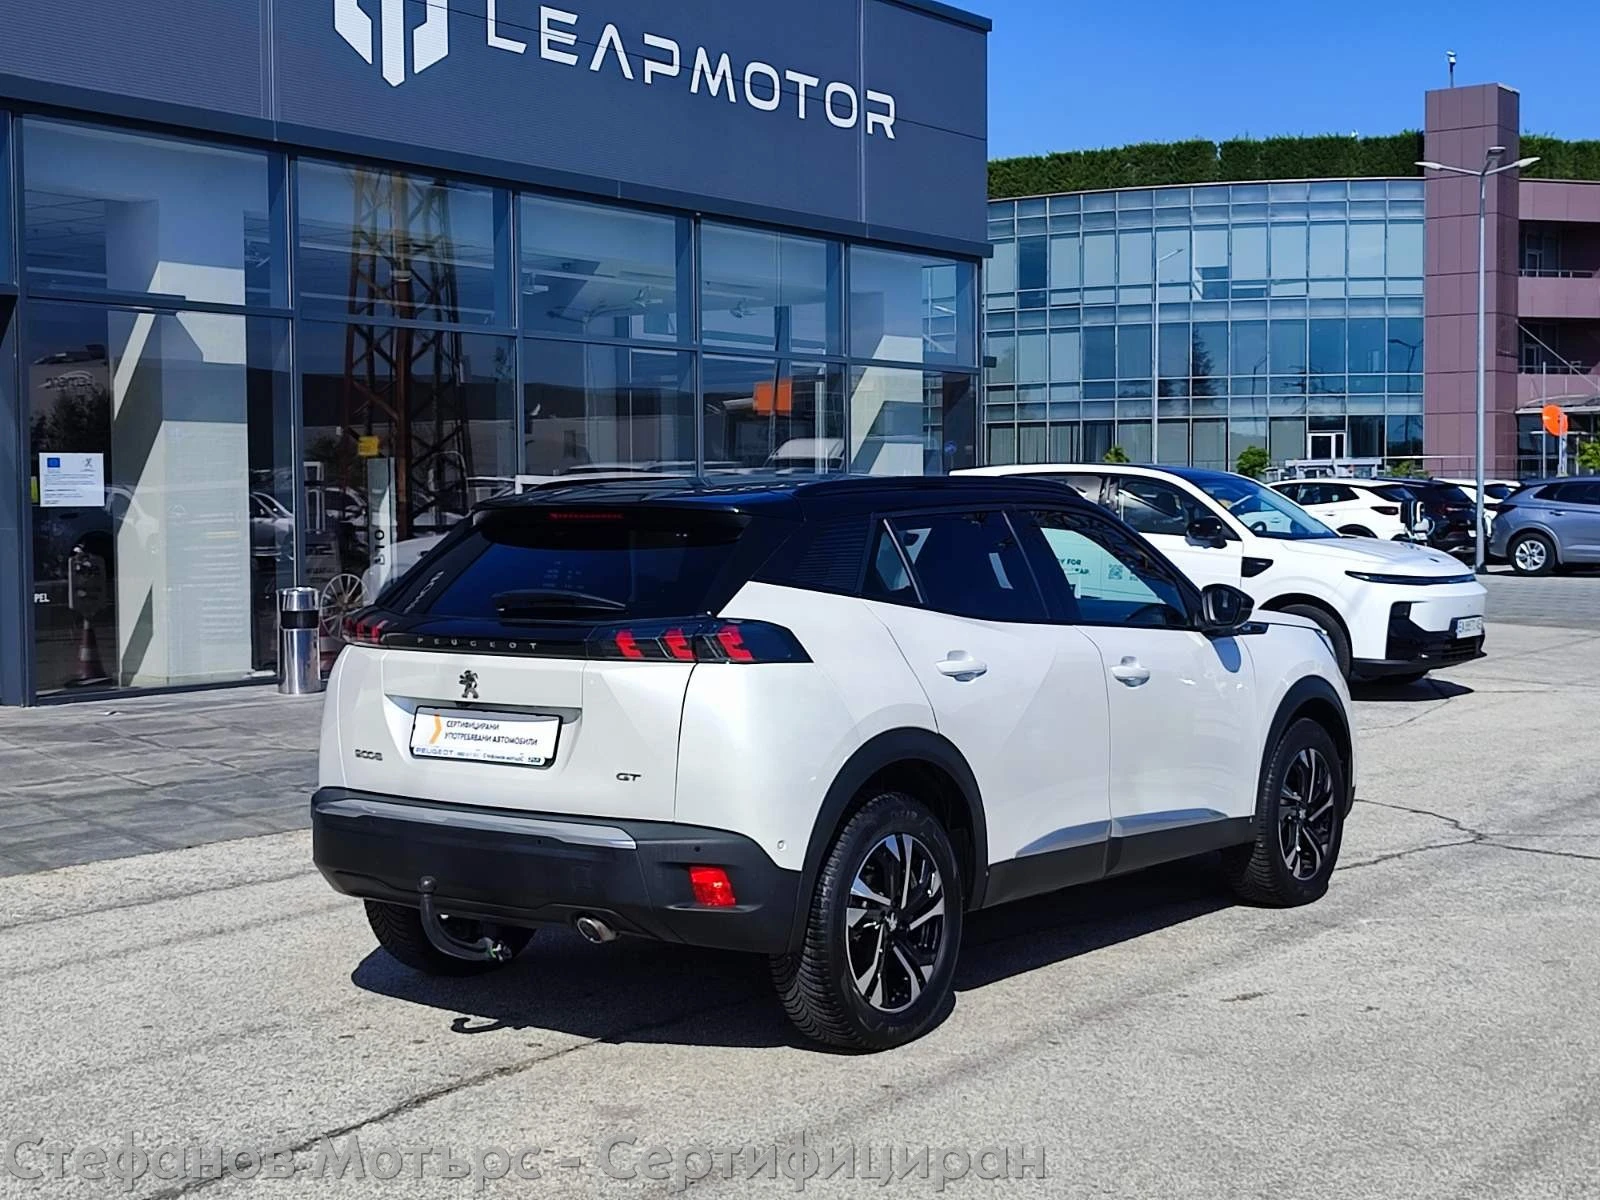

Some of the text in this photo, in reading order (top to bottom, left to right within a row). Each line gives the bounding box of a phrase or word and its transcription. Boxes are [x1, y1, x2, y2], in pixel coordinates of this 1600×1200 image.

[486, 0, 897, 140] LEAPMOTOR
[416, 636, 538, 650] PEUGEOT
[446, 719, 500, 731] СЕРТИФИЦИРАНИ
[492, 736, 538, 746] АВТОМОБИЛИ
[615, 772, 642, 782] GT
